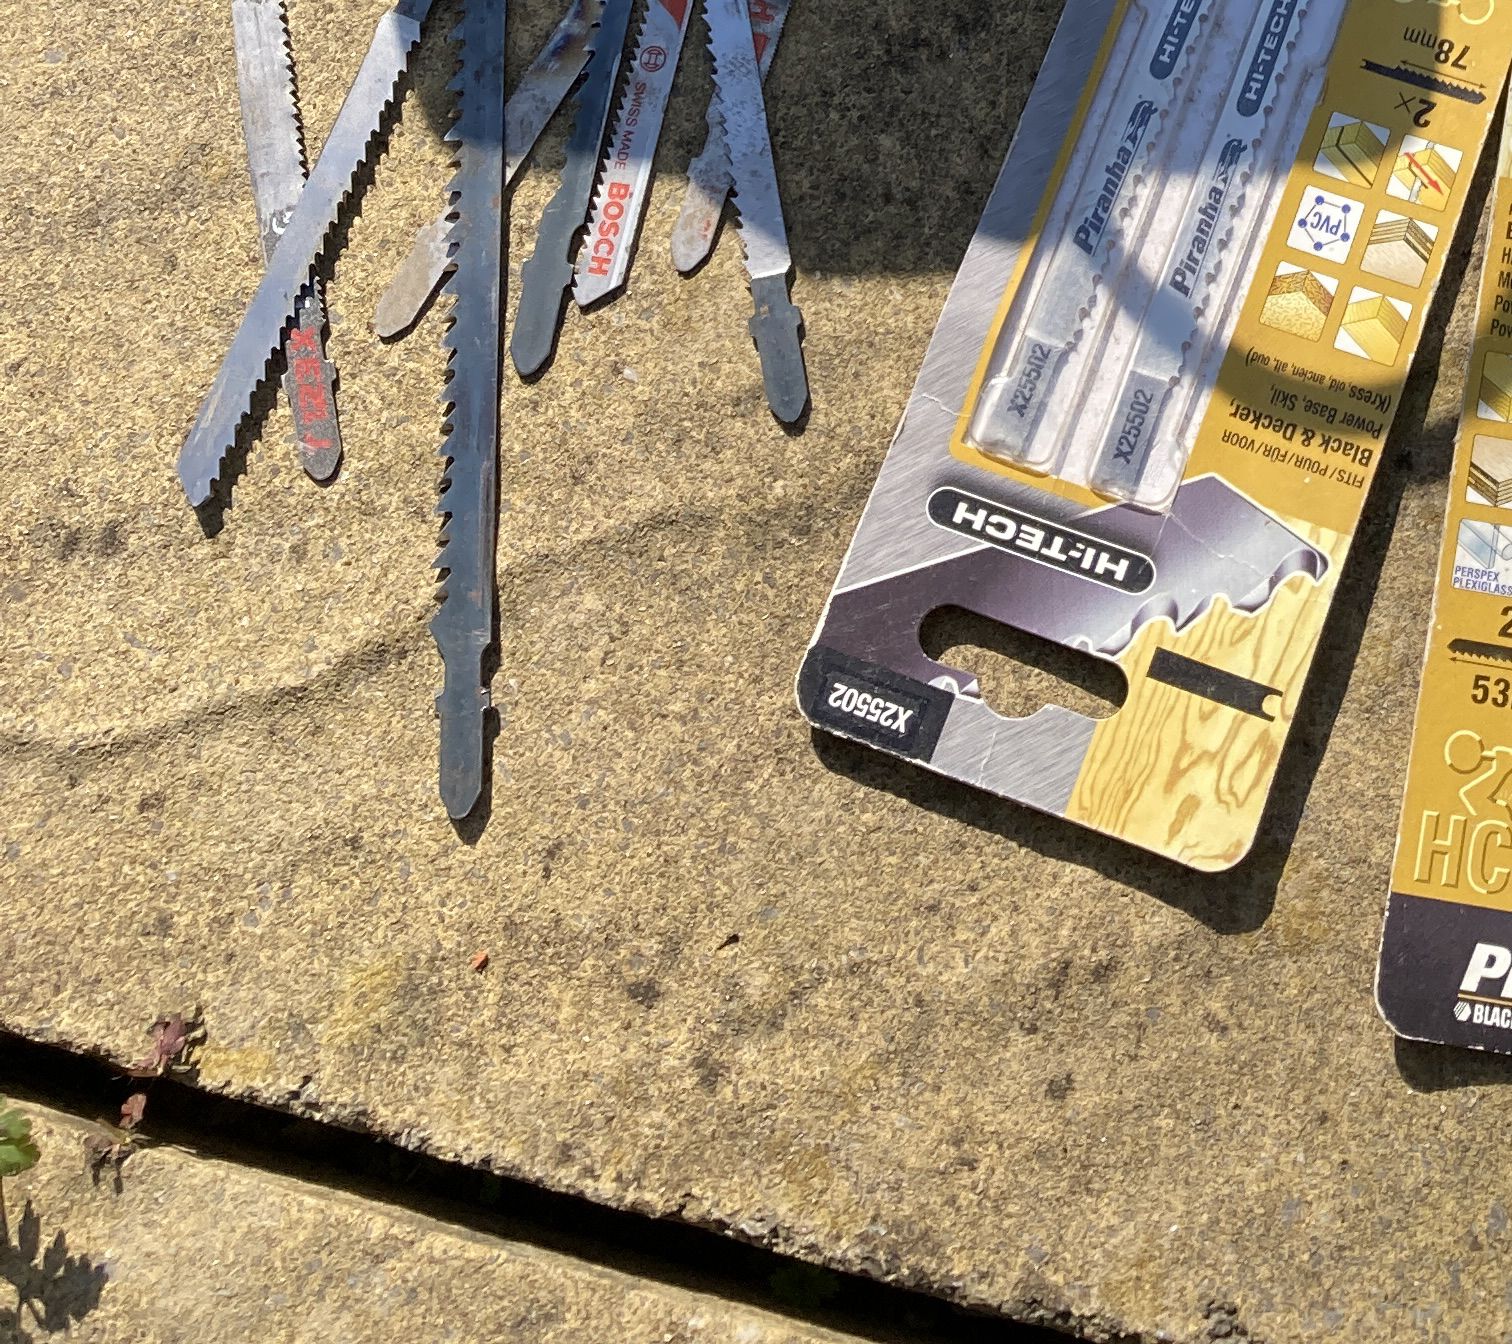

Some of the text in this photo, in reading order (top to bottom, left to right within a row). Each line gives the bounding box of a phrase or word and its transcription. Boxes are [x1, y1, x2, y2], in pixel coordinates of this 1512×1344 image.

[1403, 27, 1471, 71] 78mm
[613, 80, 646, 171] SWISS MADE
[587, 179, 632, 278] BOSCH
[1309, 211, 1342, 236] PVC
[1006, 343, 1053, 419] X25502
[1072, 145, 1136, 258] Piranha
[1111, 388, 1155, 465] X25502
[1168, 185, 1228, 298] Piranha
[1228, 398, 1374, 468] Black & Decker,
[1269, 383, 1383, 440] Power Base, Skil,
[952, 501, 1130, 582] HI-TECH
[1454, 565, 1500, 583] PERSPEX
[827, 682, 913, 734] X25502
